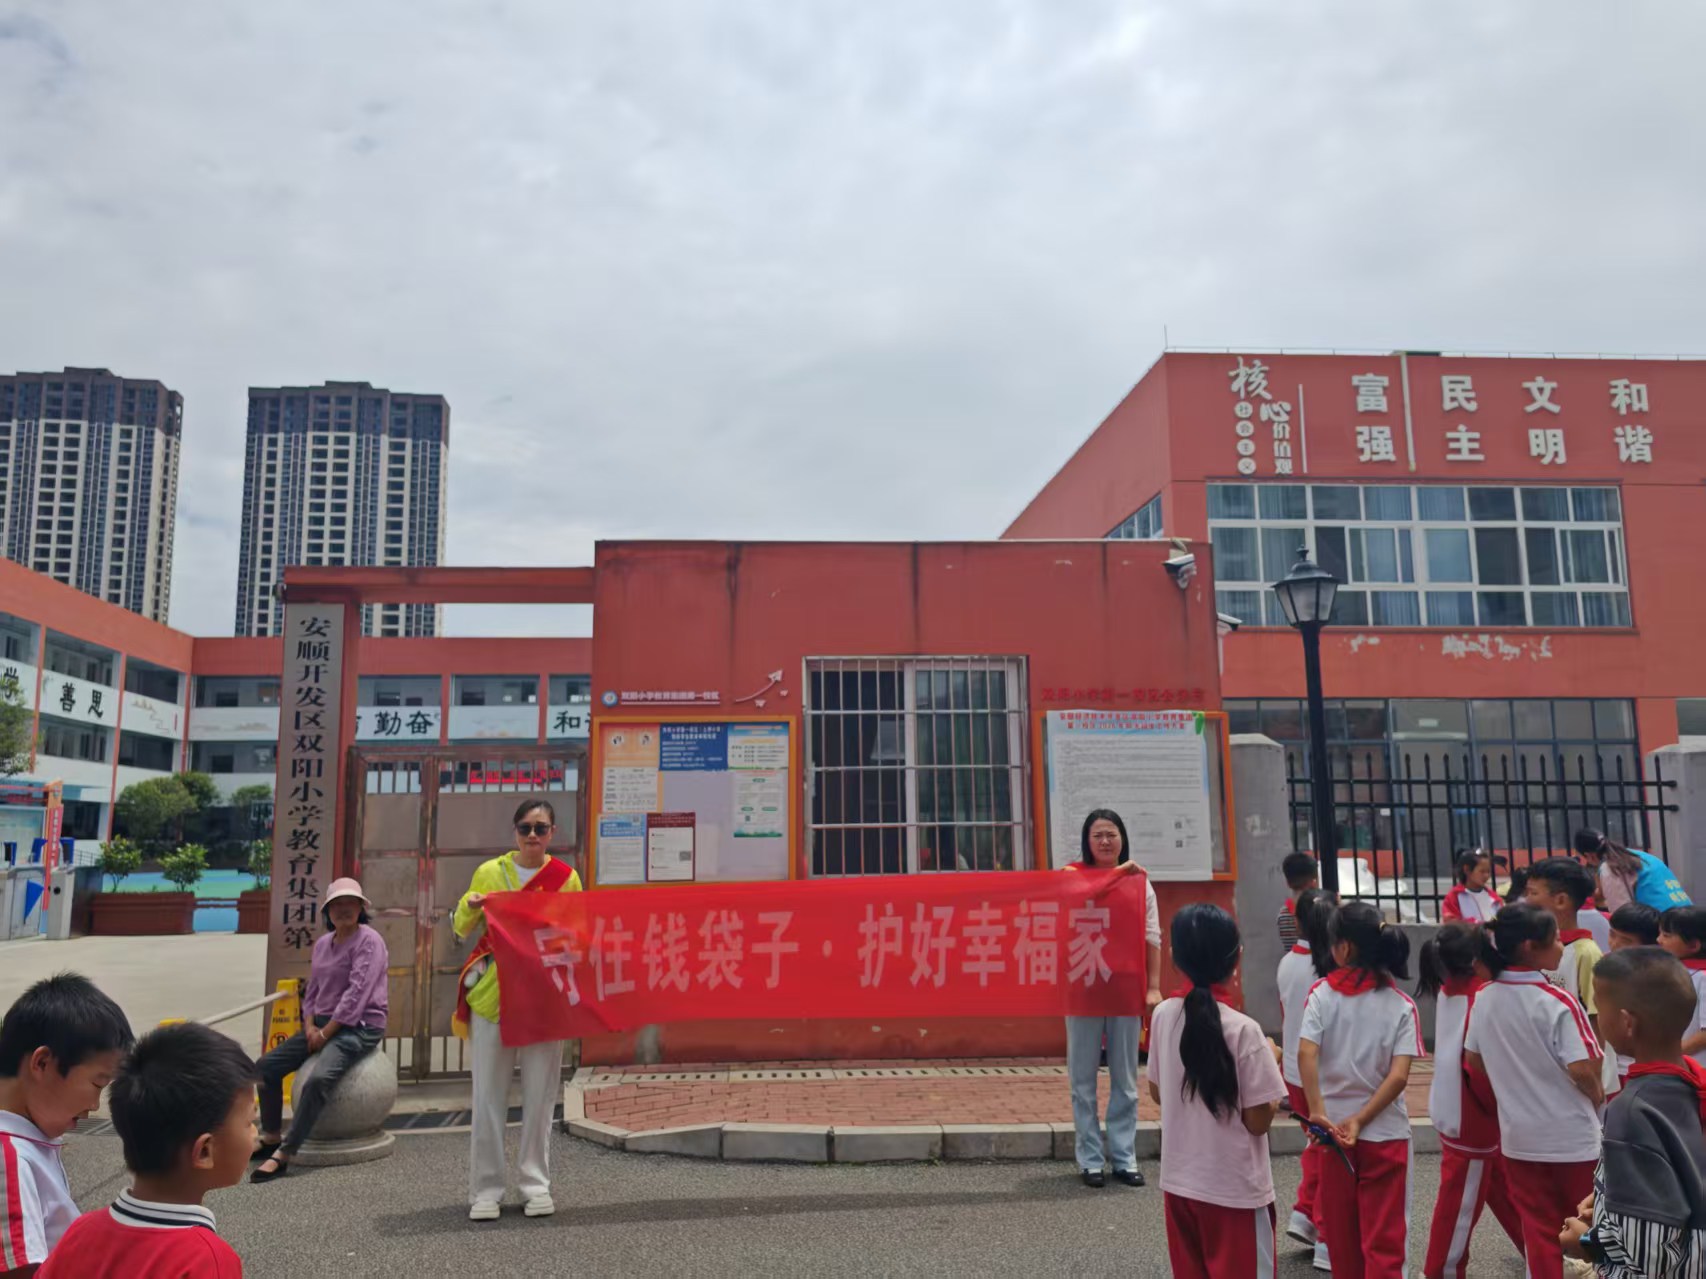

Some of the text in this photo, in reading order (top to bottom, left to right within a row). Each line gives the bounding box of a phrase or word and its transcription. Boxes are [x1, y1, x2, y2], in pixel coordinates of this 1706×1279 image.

[1351, 373, 1396, 462] 富强
[1441, 375, 1484, 462] 民主
[1522, 376, 1567, 465] 文明
[1609, 379, 1653, 463] 和谐
[60, 682, 103, 718] 善思
[355, 710, 434, 736] 勤奋
